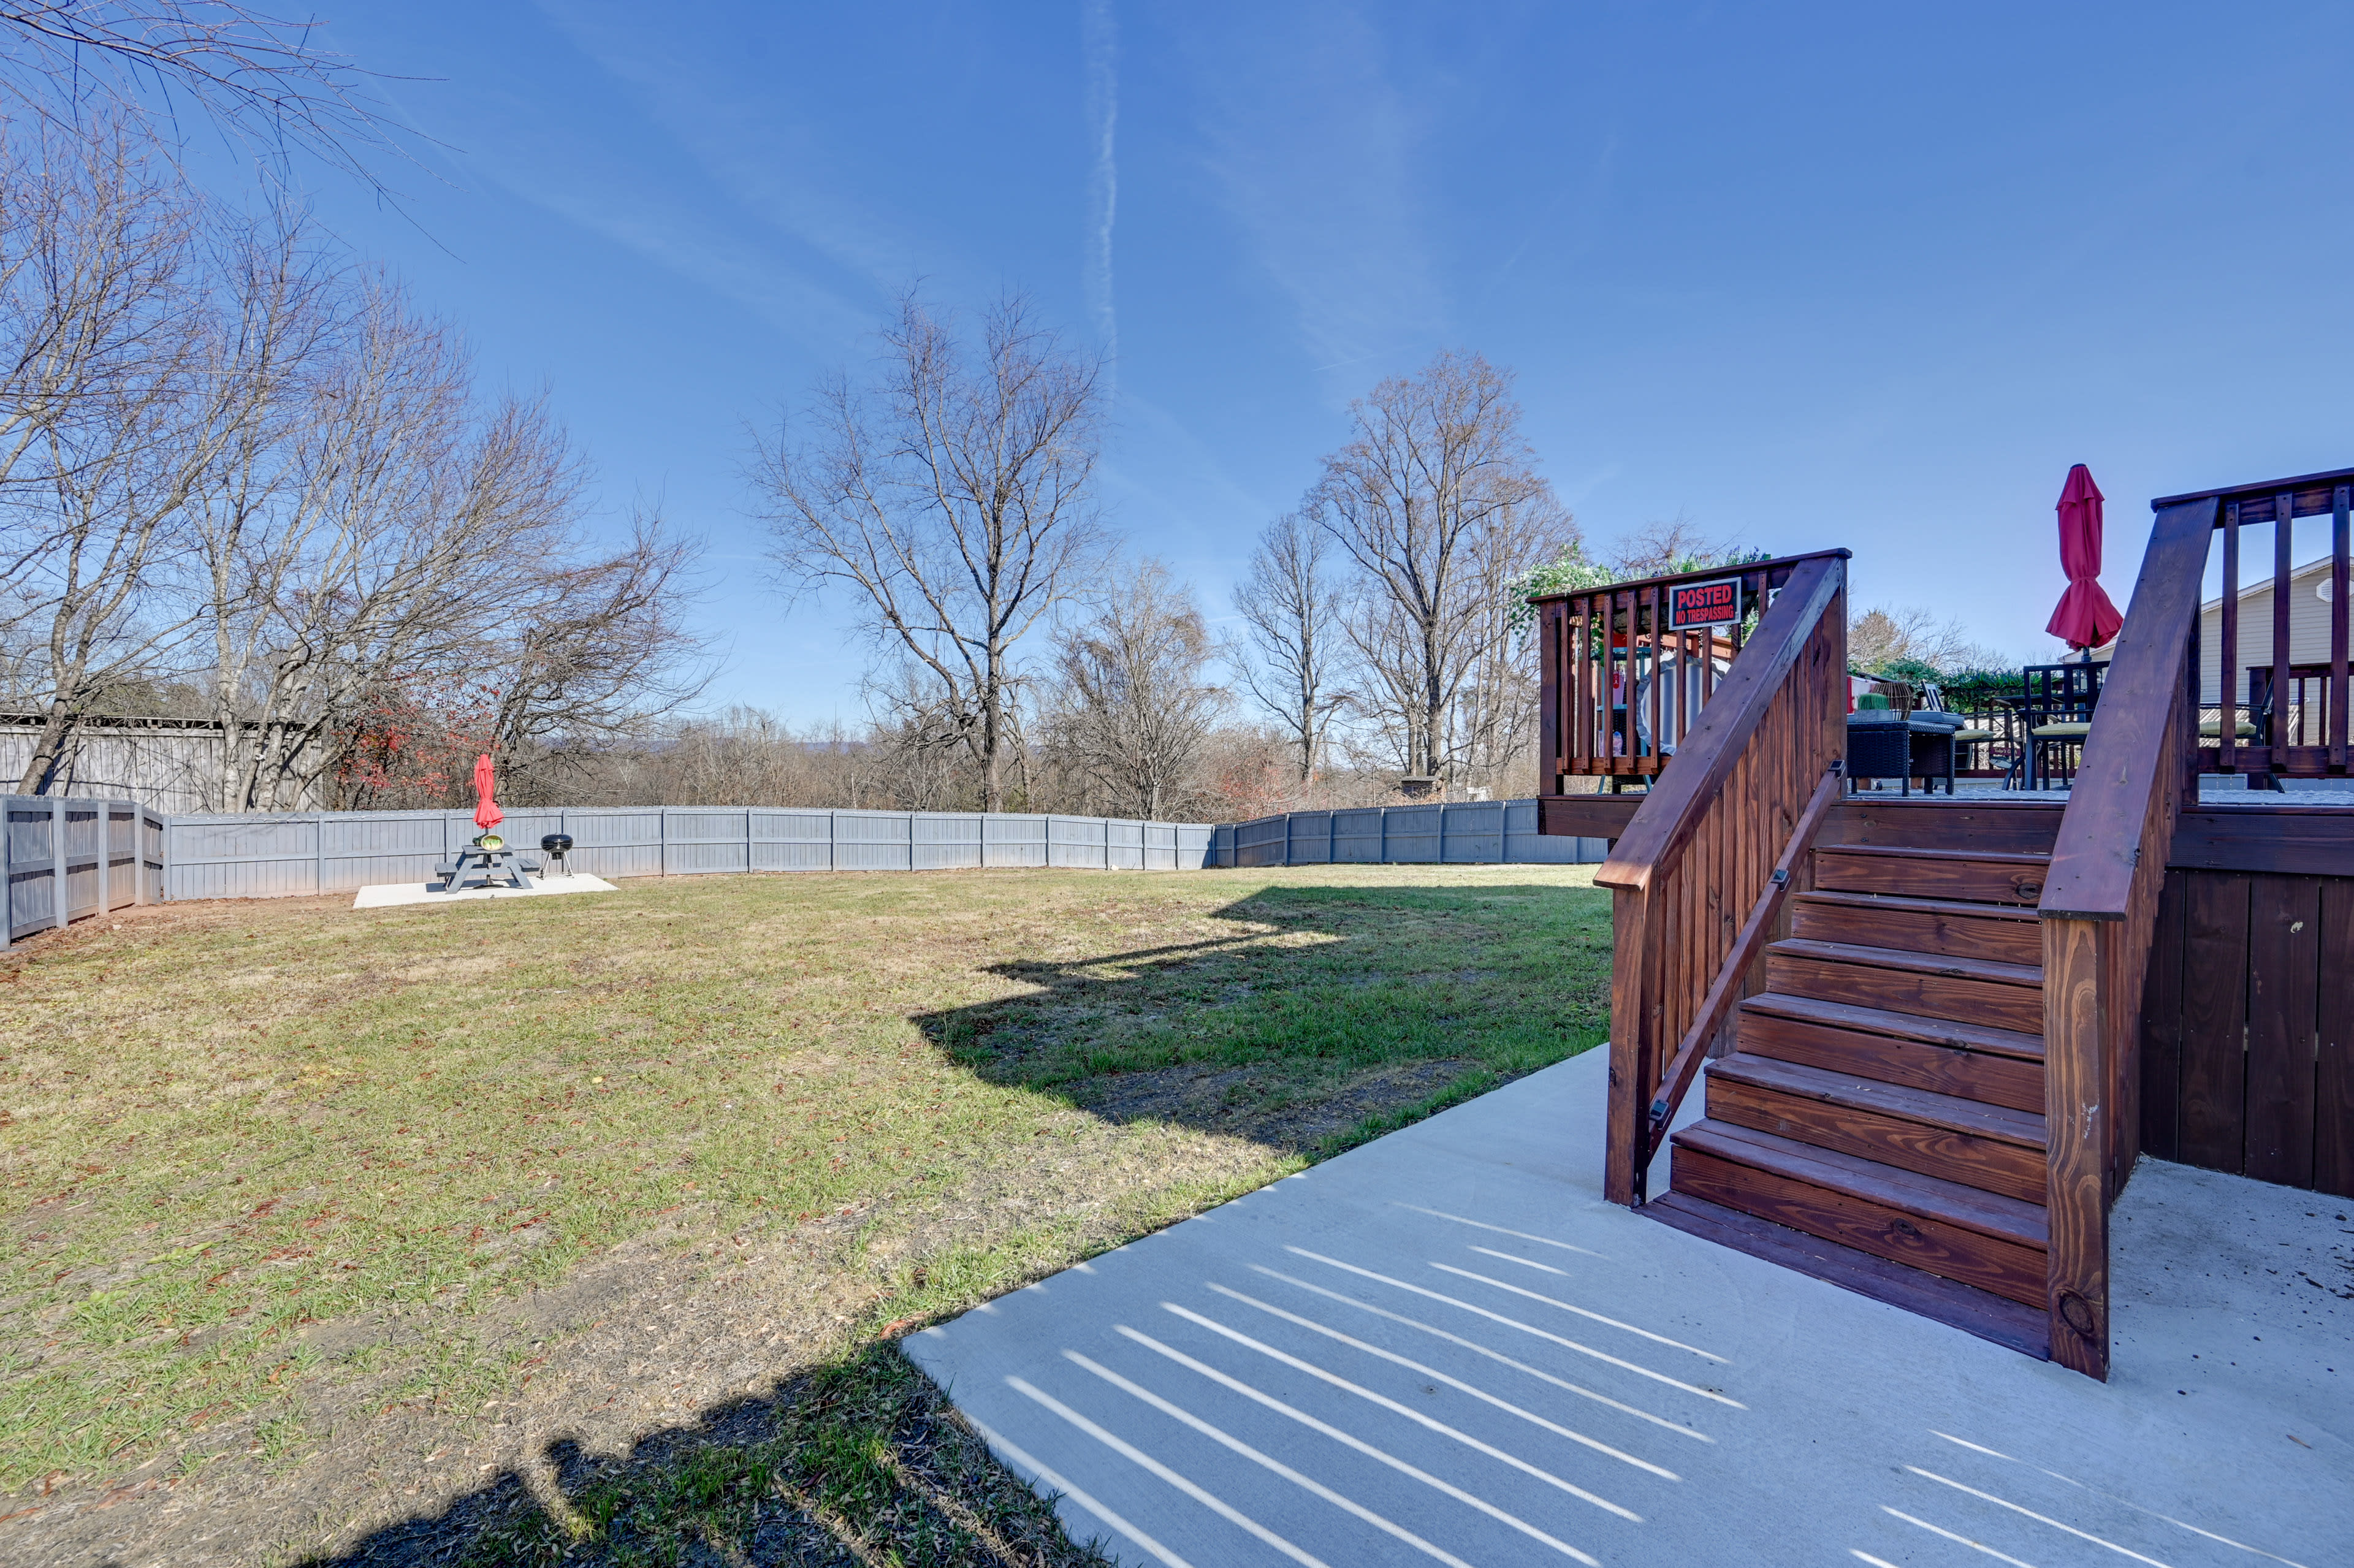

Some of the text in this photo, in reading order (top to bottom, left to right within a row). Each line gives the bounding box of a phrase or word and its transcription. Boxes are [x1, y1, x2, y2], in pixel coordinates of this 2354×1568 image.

[1678, 585, 1732, 609] POSTED
[1676, 604, 1734, 624] NO TRESPASSING
